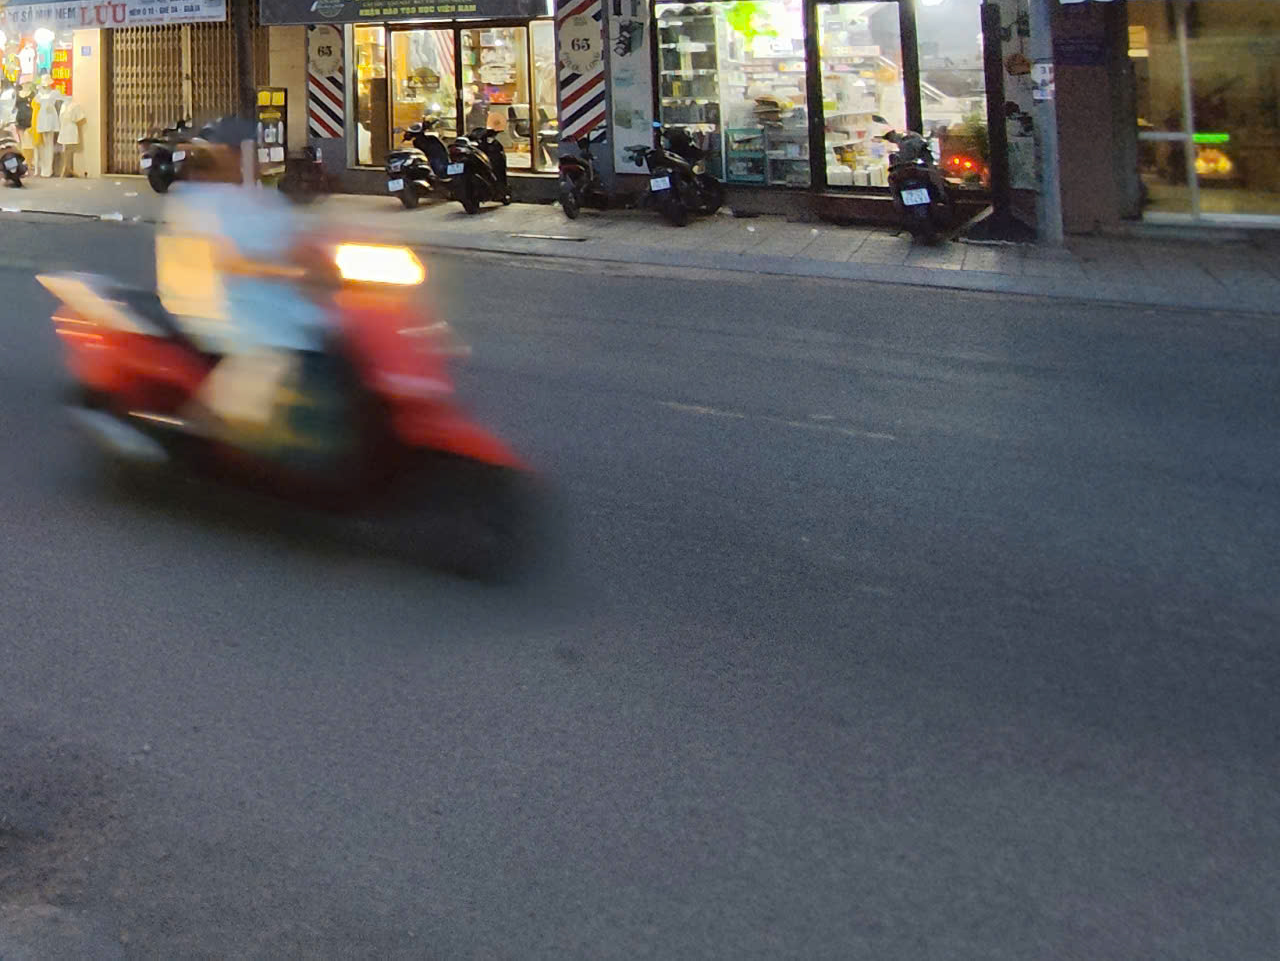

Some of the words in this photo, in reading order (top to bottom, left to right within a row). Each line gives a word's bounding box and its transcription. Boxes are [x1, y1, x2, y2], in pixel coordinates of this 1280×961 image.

[80, 0, 127, 25] LƯU
[571, 38, 590, 51] 65
[317, 45, 333, 58] 65
